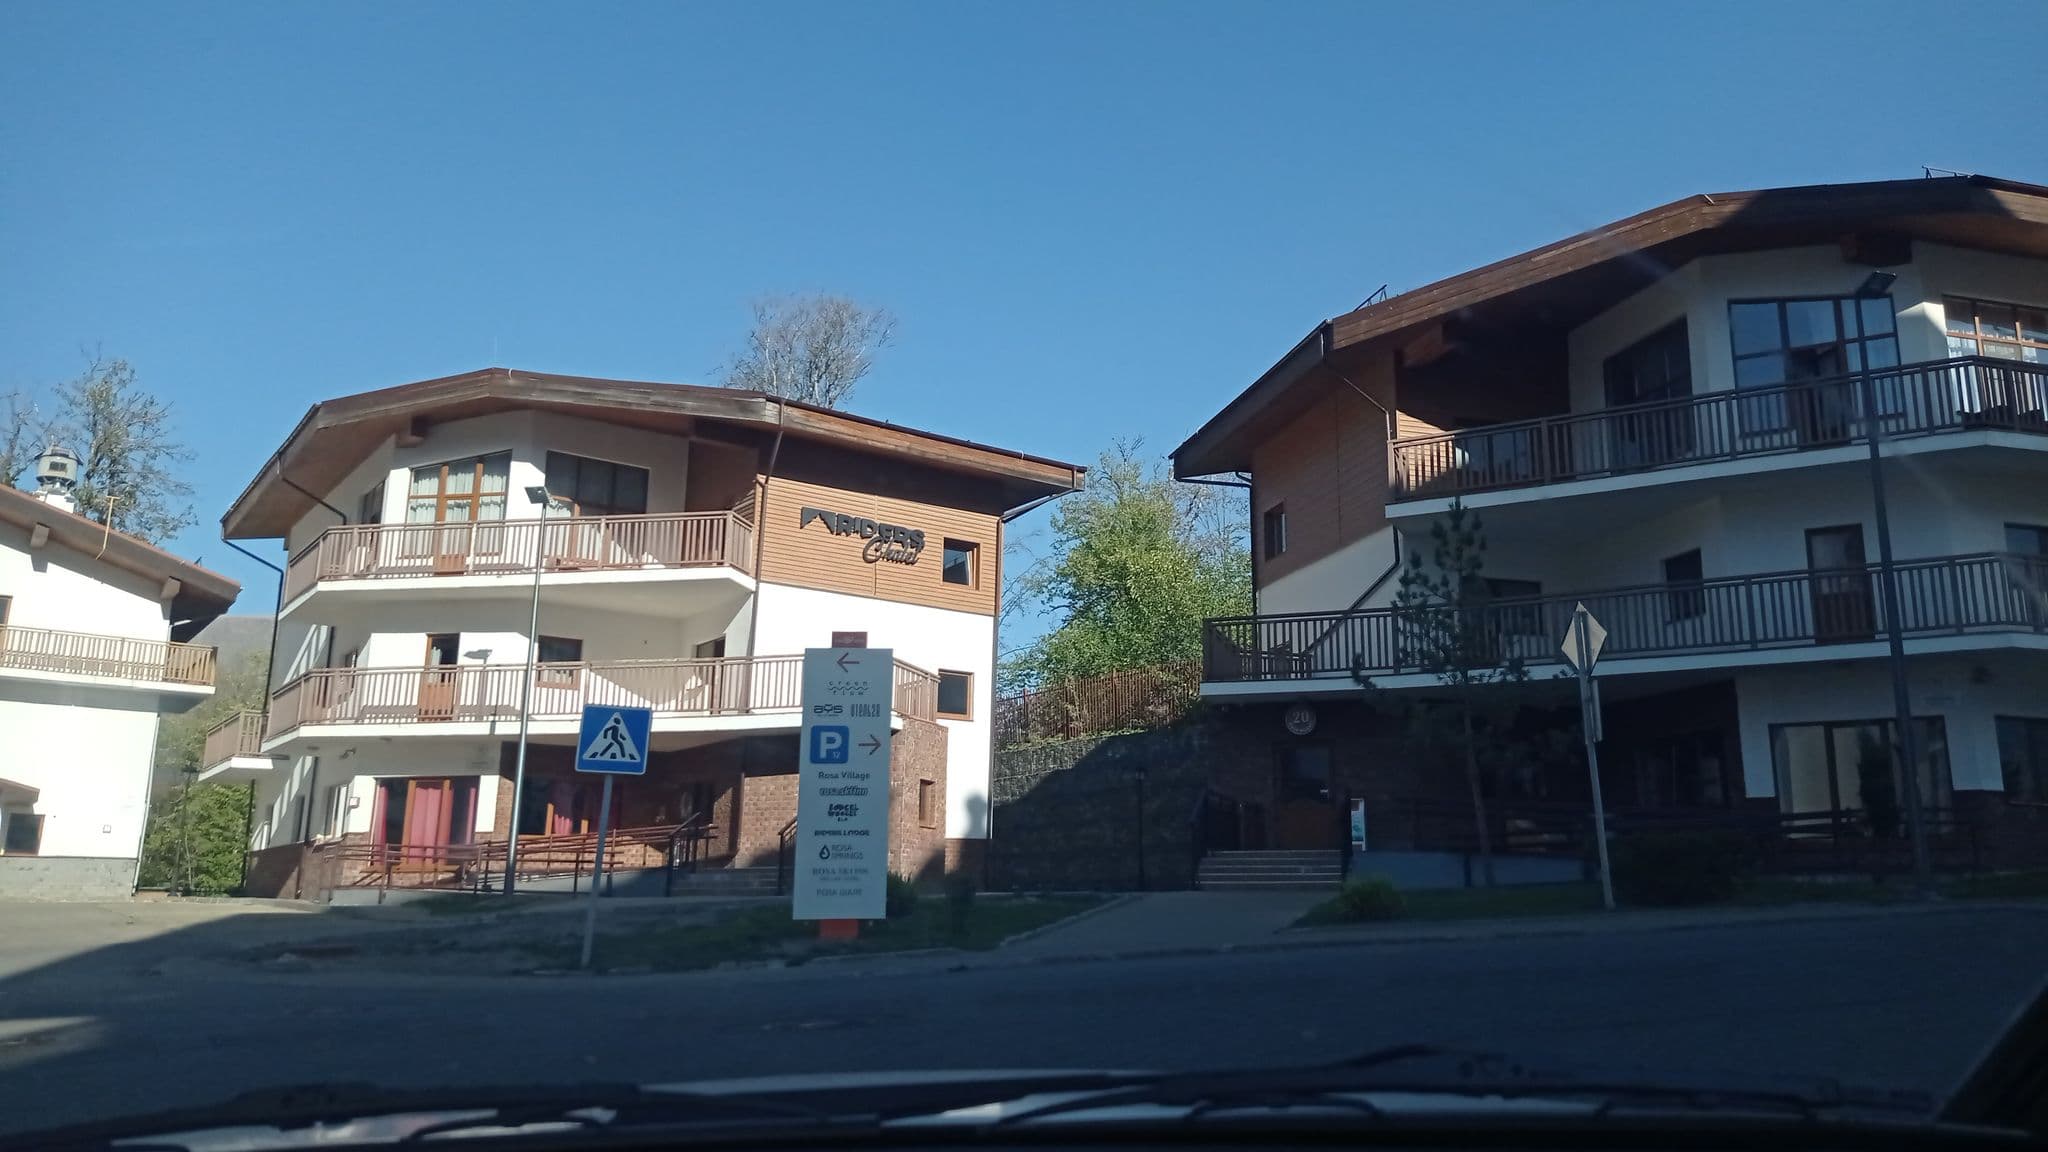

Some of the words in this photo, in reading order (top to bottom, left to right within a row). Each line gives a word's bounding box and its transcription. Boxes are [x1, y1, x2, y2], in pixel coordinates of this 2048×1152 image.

[836, 513, 925, 552] RIDERS
[820, 731, 843, 759] P
[818, 771, 839, 779] Rosa
[841, 771, 871, 781] Village
